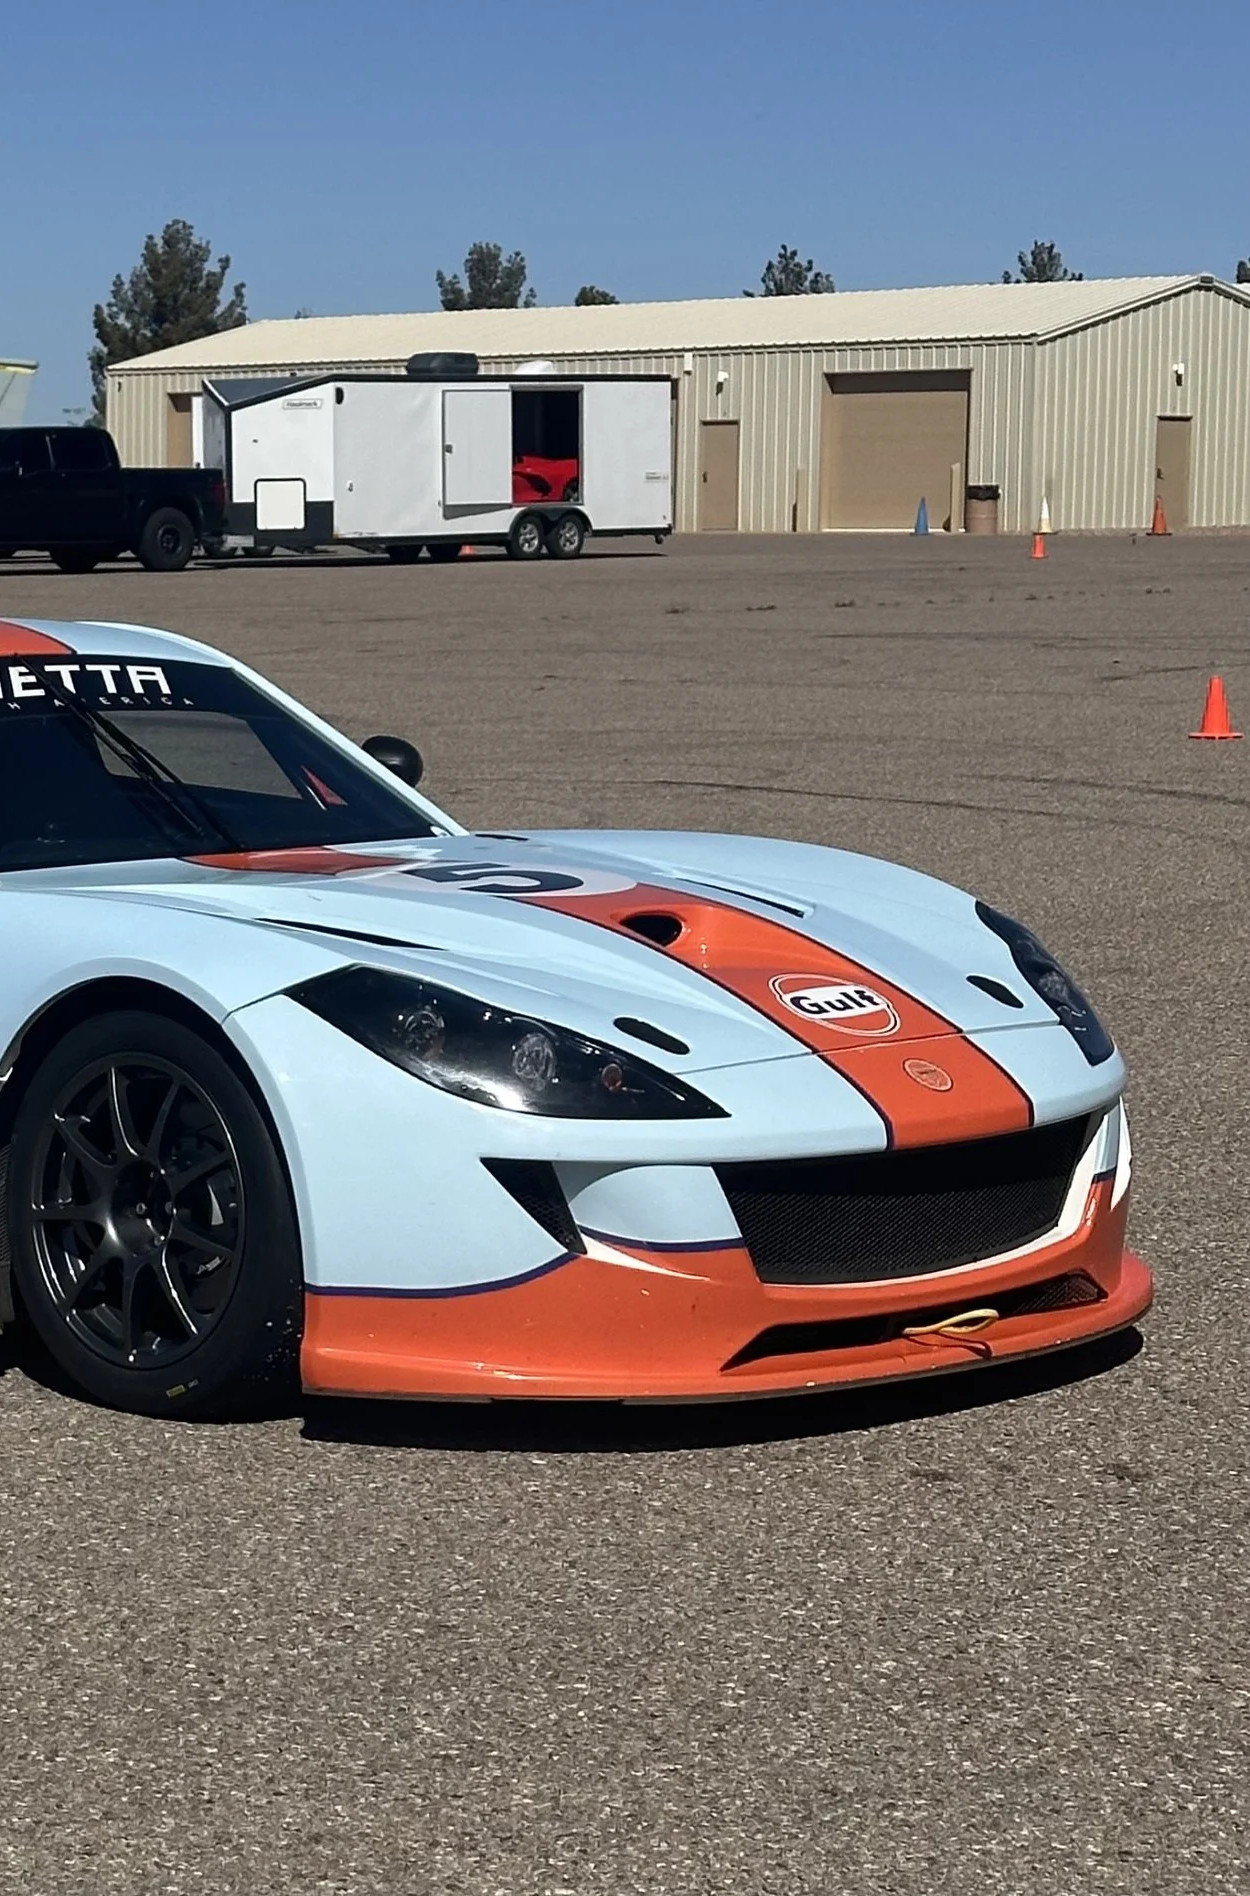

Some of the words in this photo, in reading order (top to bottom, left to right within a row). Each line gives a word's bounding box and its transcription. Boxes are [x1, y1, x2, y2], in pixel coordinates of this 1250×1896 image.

[53, 696, 195, 708] AERICA
[400, 862, 584, 894] 5
[789, 989, 880, 1015] Gulf
